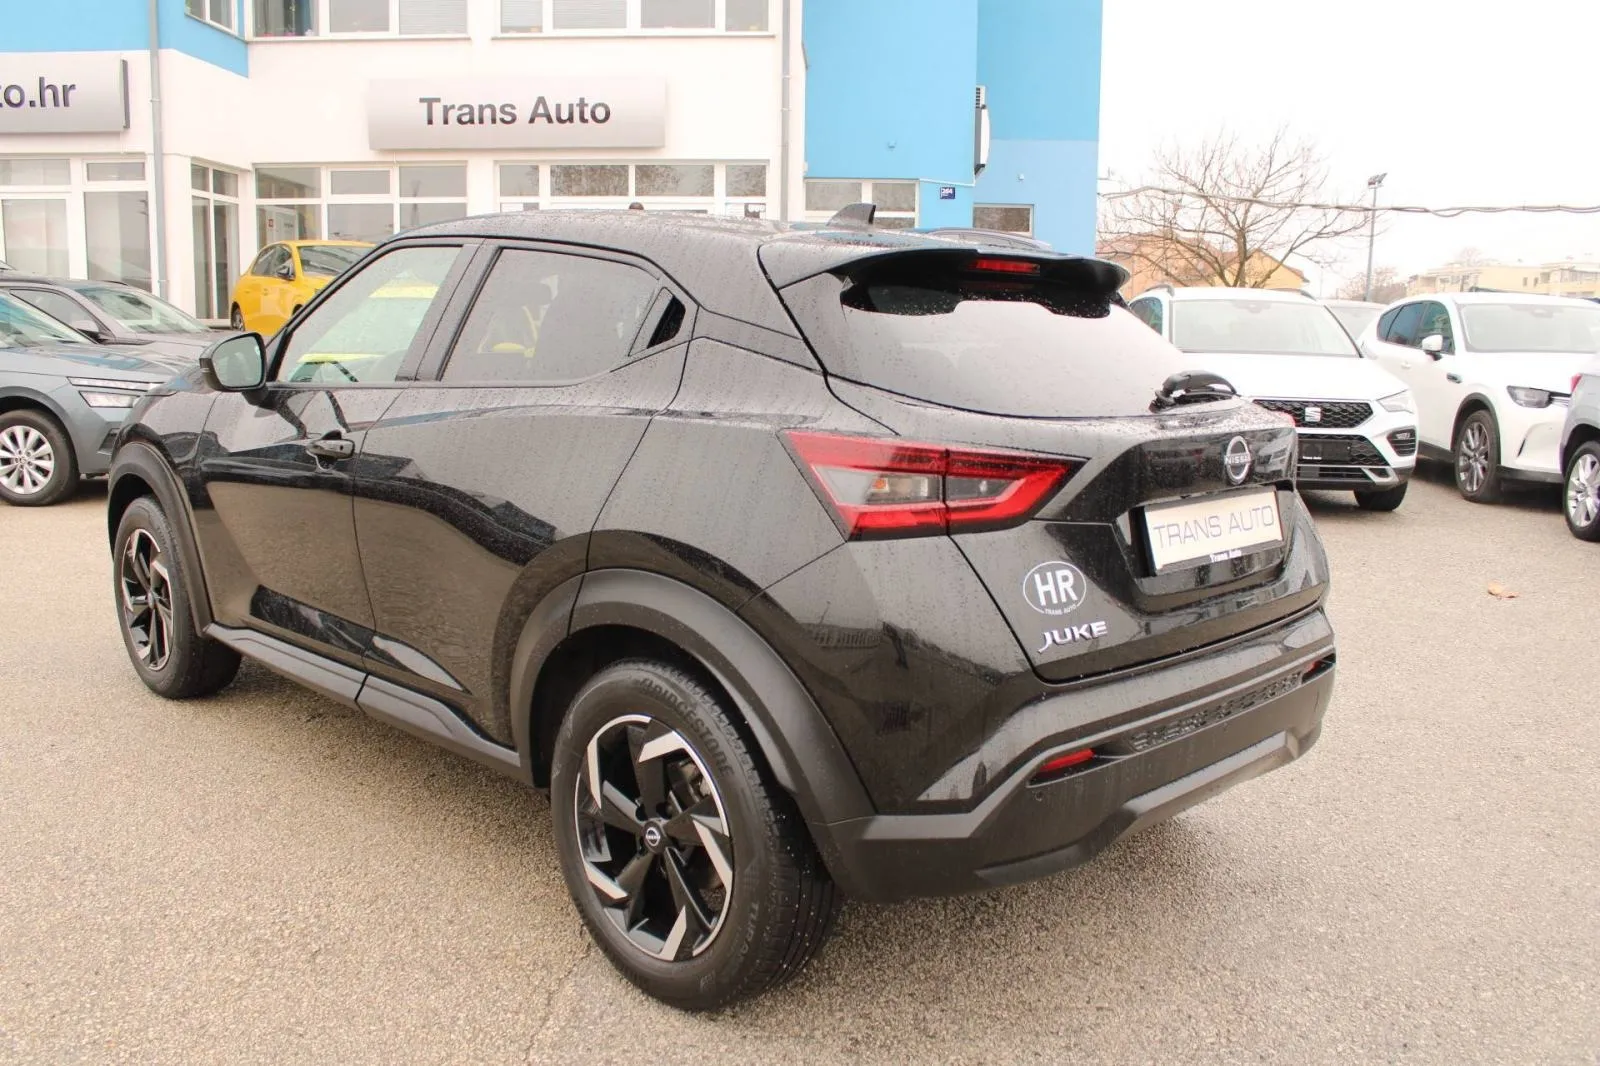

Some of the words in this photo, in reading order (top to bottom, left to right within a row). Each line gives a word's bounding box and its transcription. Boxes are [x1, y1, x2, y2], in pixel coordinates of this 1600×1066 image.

[0, 76, 76, 108] o.hr
[419, 97, 517, 125] Trans
[528, 95, 611, 124] Auto
[1153, 515, 1222, 549] TRANS
[1229, 505, 1275, 535] AUTO
[1034, 569, 1078, 606] HR
[1037, 621, 1108, 653] JUKE
